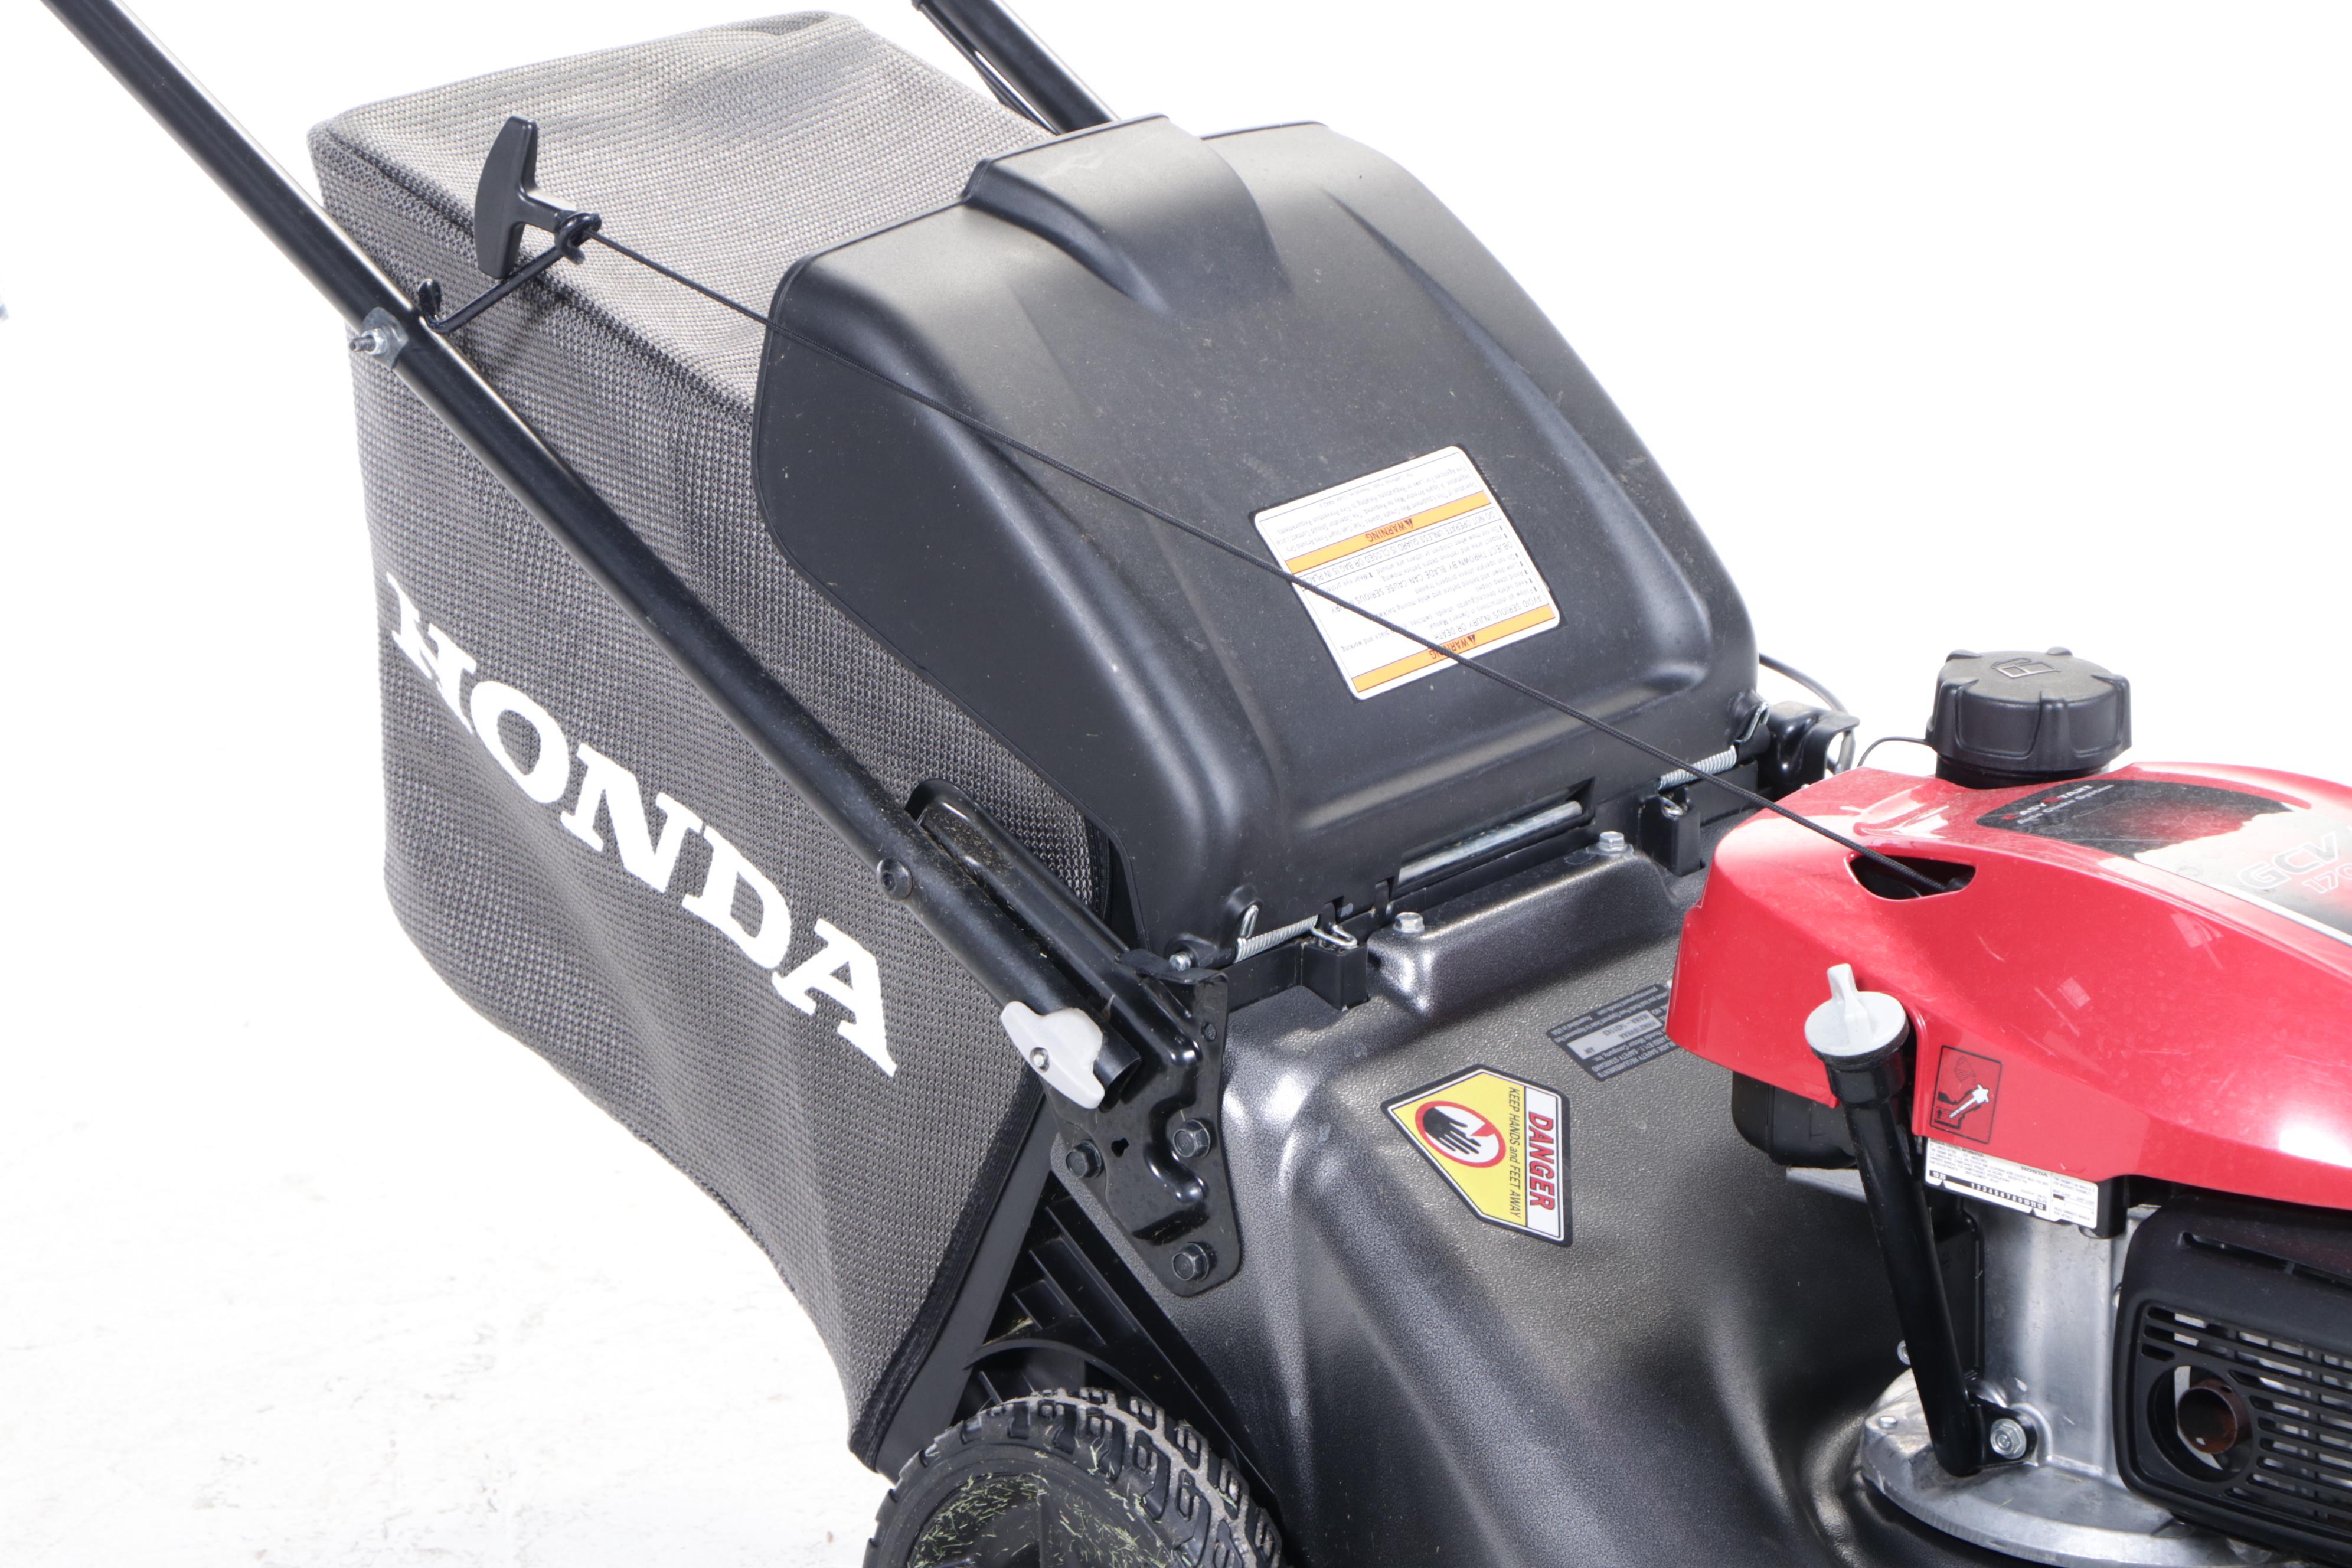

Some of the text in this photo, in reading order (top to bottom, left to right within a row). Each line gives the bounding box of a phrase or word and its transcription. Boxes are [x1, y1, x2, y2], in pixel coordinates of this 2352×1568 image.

[1364, 521, 1407, 543] WARNING
[1300, 510, 1495, 586] DO NOT OPERATE UNLESS GUARD IS CLOSED OR BAG IS IN PLAC
[1487, 541, 1513, 556] OBJECT
[1446, 561, 1458, 570] BY
[1456, 550, 1487, 567] THROWN
[1407, 573, 1425, 584] CAN
[1423, 564, 1448, 579] BLADE
[1384, 579, 1409, 593] CAUSE
[1354, 587, 1385, 605] SERIOUS
[1521, 594, 1543, 608] AVOID
[1491, 602, 1522, 619] SERIOUS
[1455, 622, 1468, 633] OR
[1466, 613, 1493, 629] INJURY
[1427, 637, 1469, 659] WARNG
[387, 572, 897, 1077] HONDA
[2237, 831, 2338, 890] GCV
[1617, 1048, 1639, 1060] SAFETY
[1636, 1047, 1659, 1061] SAFETY
[1595, 1056, 1640, 1078] REQUIREMENTS
[1509, 1087, 1521, 1218] KEEP HANDS and FEET AWAY
[1528, 1111, 1555, 1210] DANGER
[2021, 1166, 2048, 1178] HONDA
